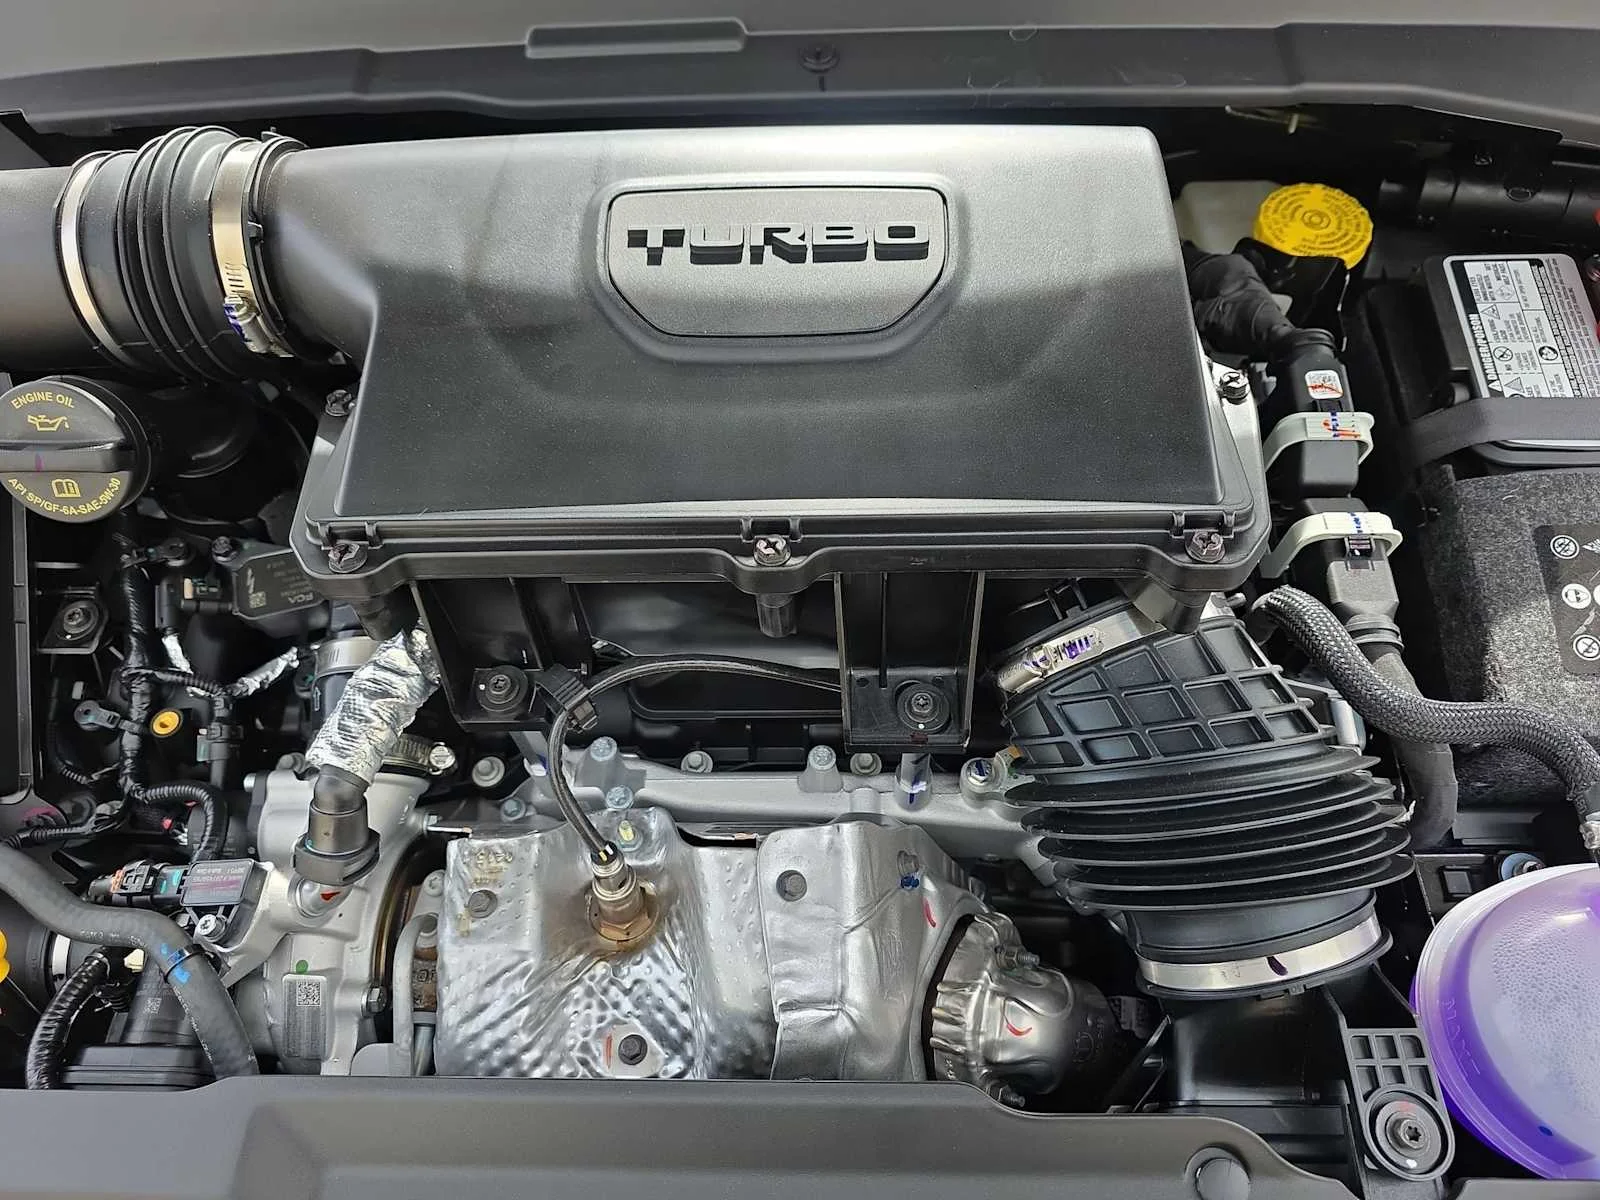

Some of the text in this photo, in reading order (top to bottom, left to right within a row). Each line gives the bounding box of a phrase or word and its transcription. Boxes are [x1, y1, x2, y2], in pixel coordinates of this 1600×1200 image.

[627, 222, 930, 266] TURBO
[1468, 313, 1498, 381] DANGER/POISON
[10, 391, 75, 410] ENGINE OIL
[7, 479, 27, 495] API
